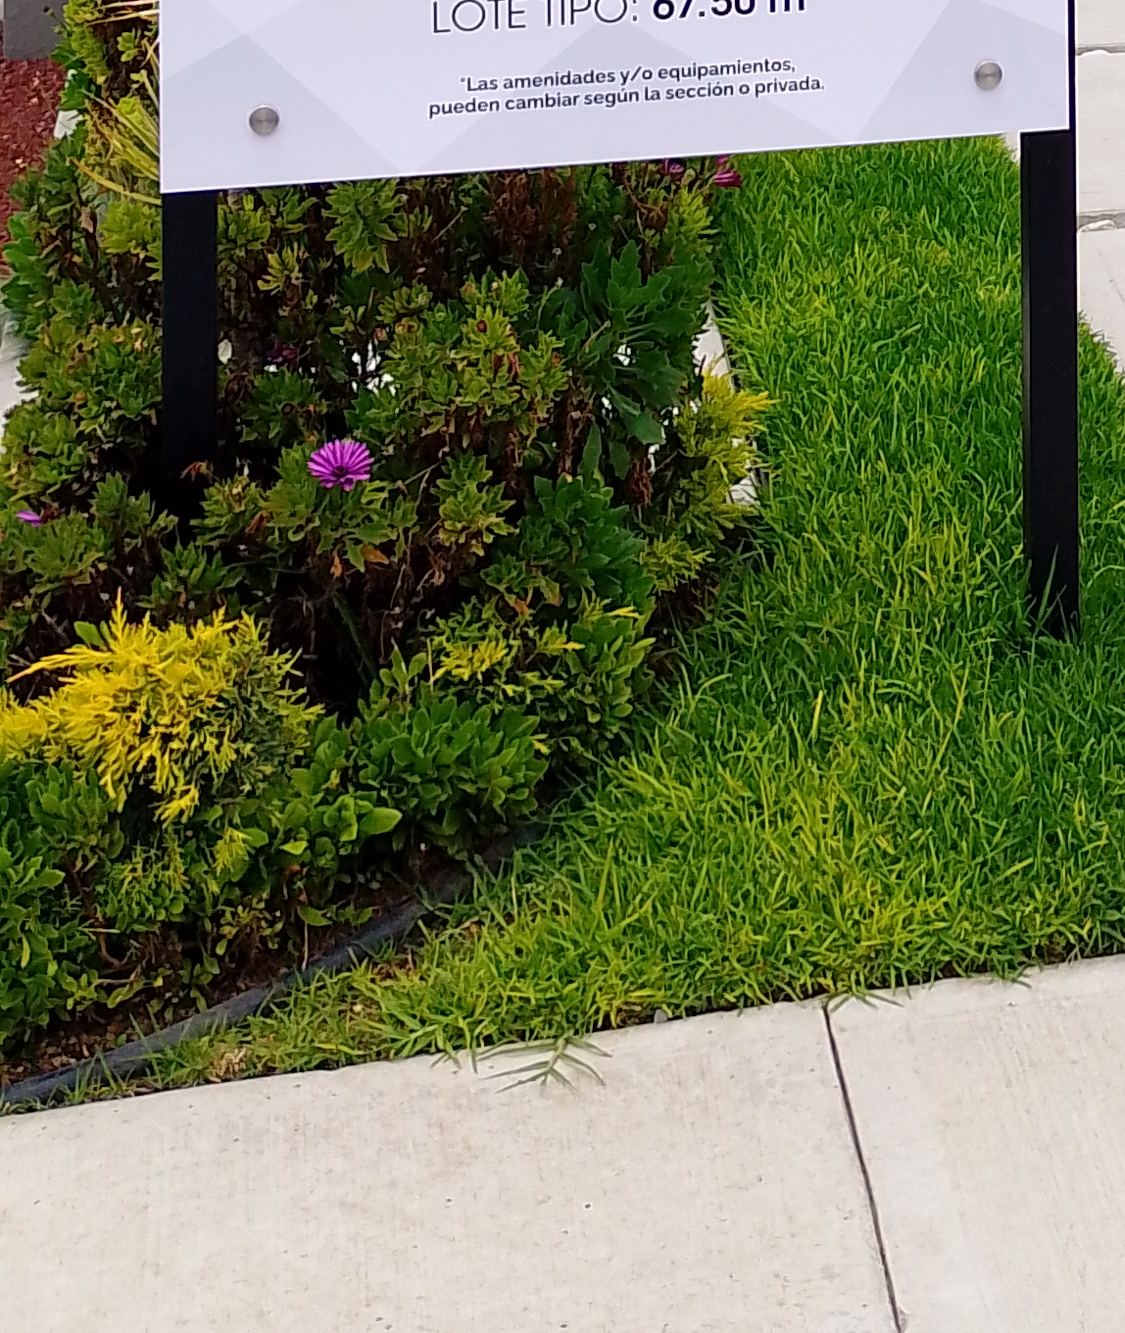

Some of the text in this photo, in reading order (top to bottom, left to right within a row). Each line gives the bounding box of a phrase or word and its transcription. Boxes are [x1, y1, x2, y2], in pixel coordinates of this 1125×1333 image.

[503, 69, 616, 90] amenidades
[619, 66, 653, 87] y/o
[657, 58, 795, 83] equipamientos,
[429, 75, 825, 120] pueden cambiar según la sección o privada.
